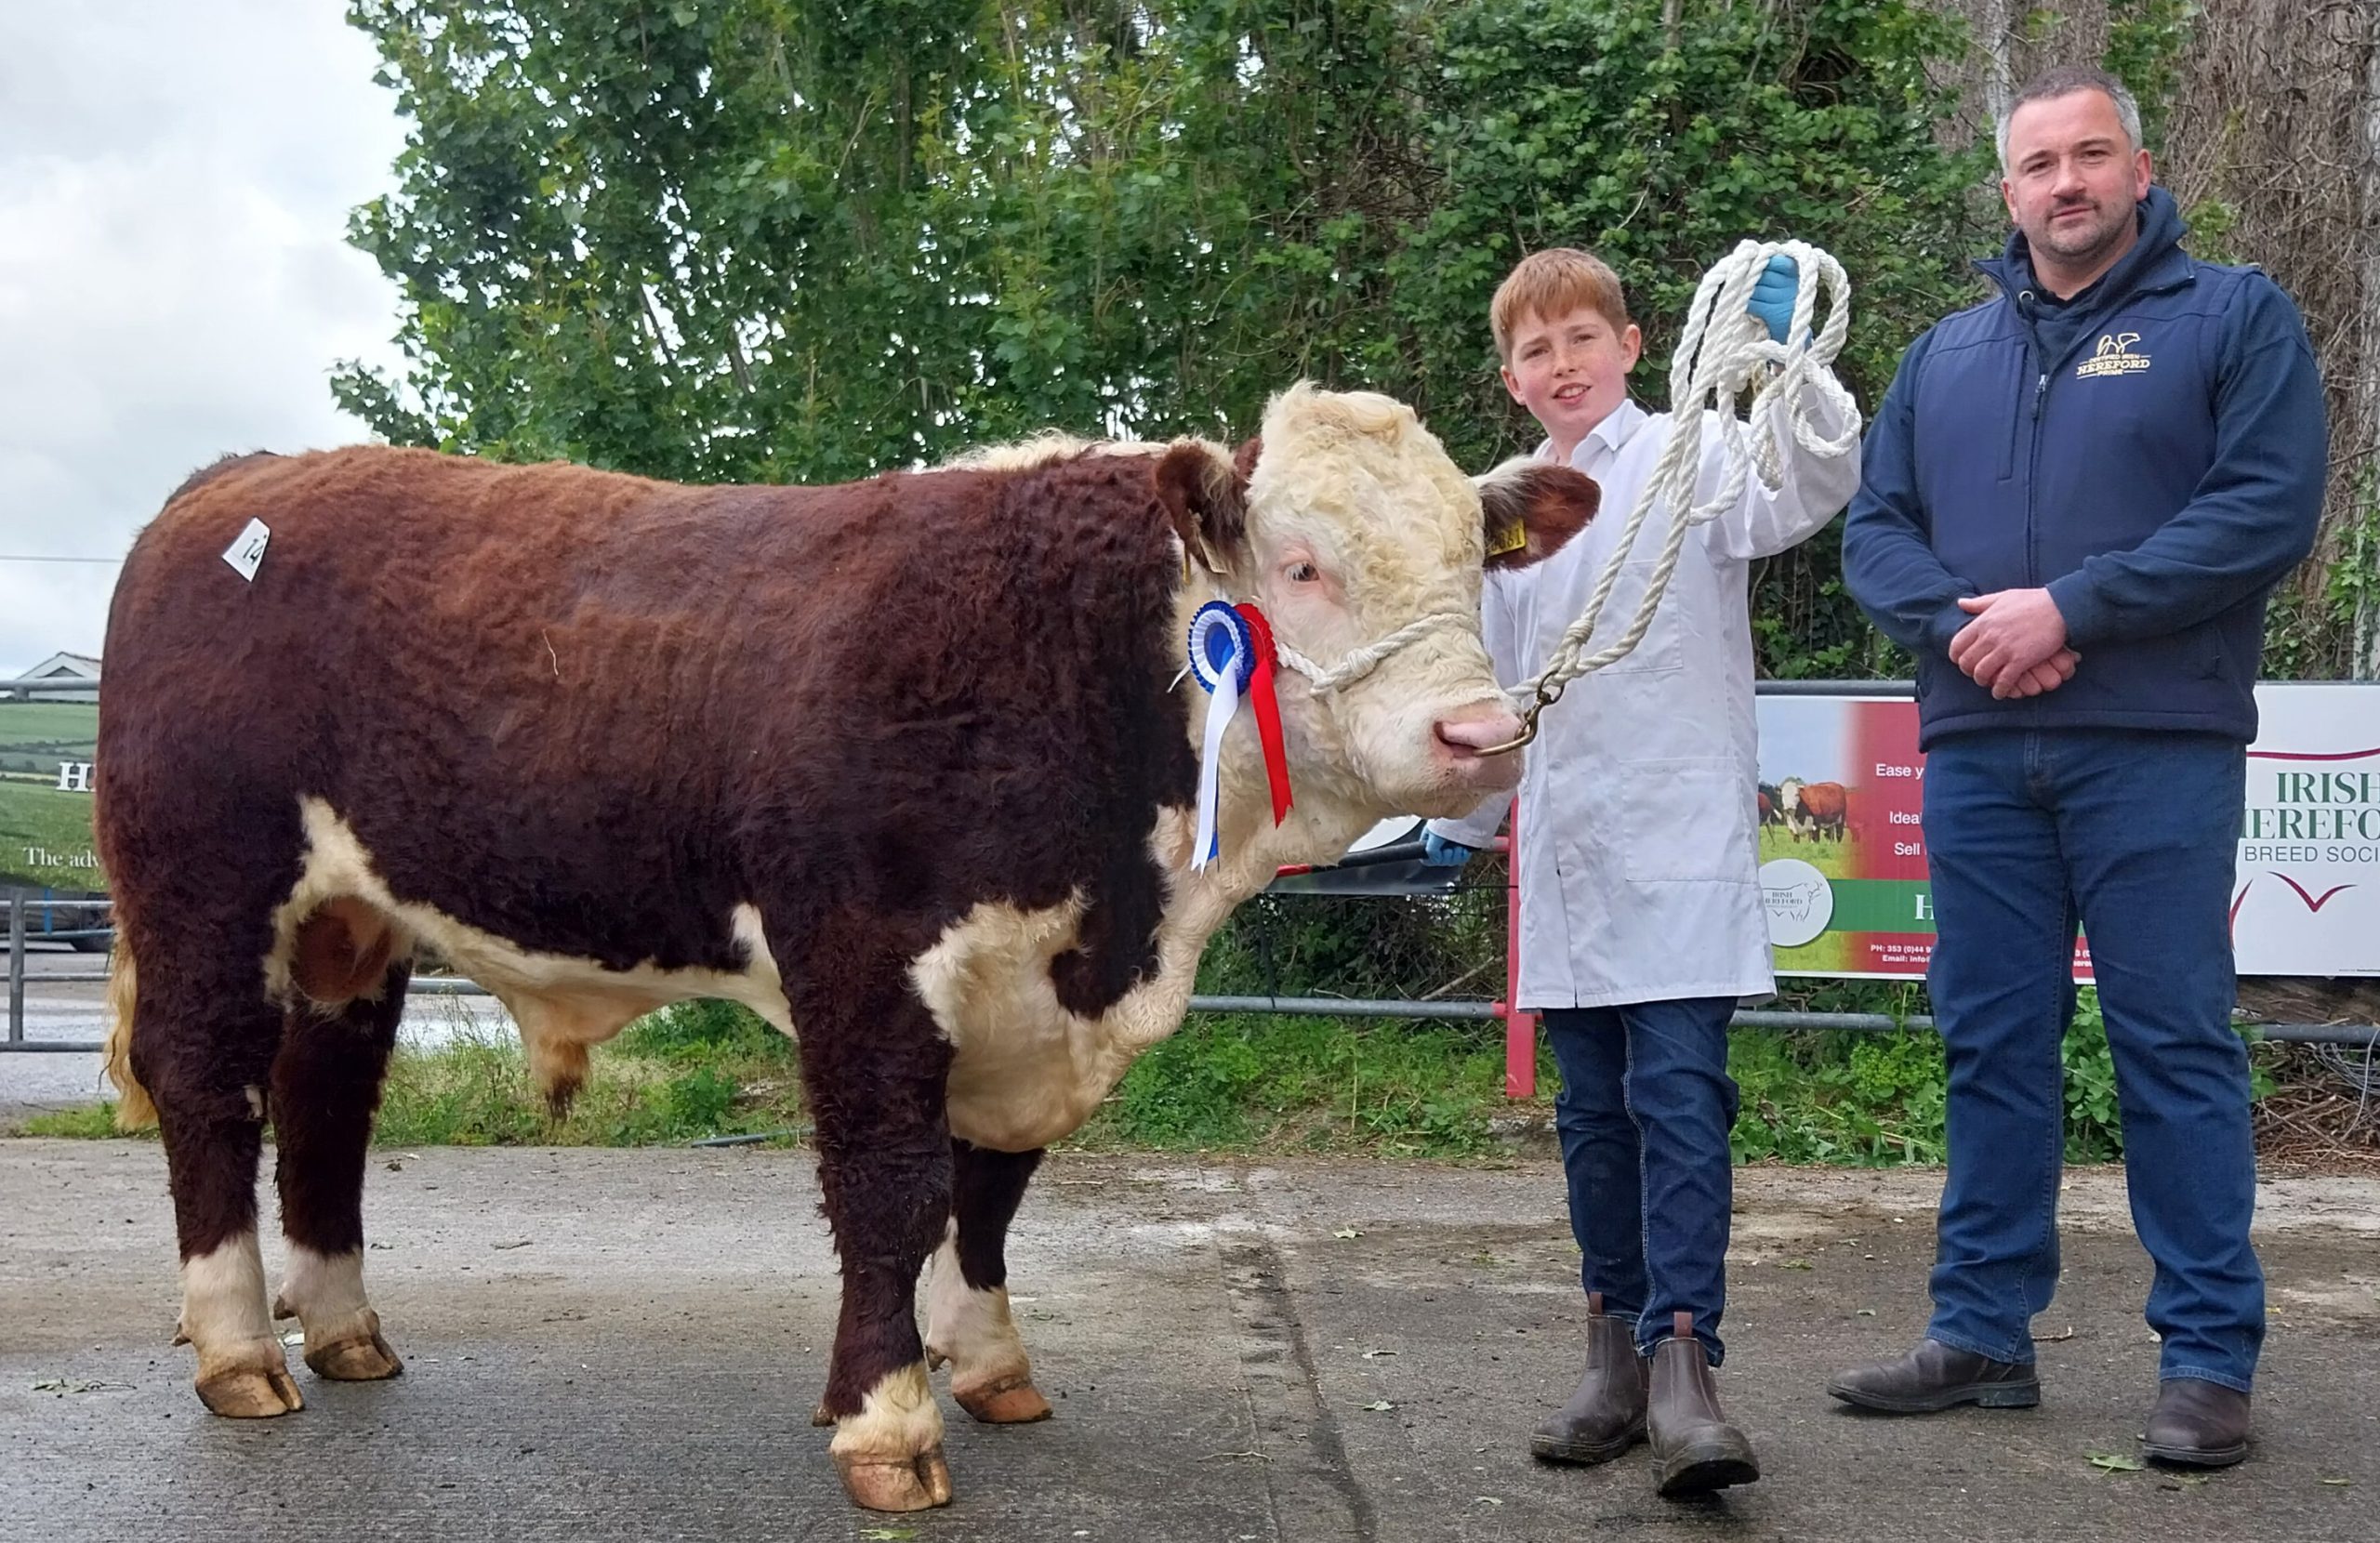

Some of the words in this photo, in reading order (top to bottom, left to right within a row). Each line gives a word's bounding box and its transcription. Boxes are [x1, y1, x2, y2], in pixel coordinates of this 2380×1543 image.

[2076, 359, 2150, 376] HEREFORD
[56, 761, 97, 792] H
[1875, 763, 1911, 777] Ease
[2276, 772, 2380, 804] IRISH
[2241, 808, 2380, 840] EREFO
[22, 847, 62, 866] The
[1894, 842, 1921, 856] Sell
[2245, 846, 2318, 862] BREED
[2326, 846, 2379, 863] SOCI
